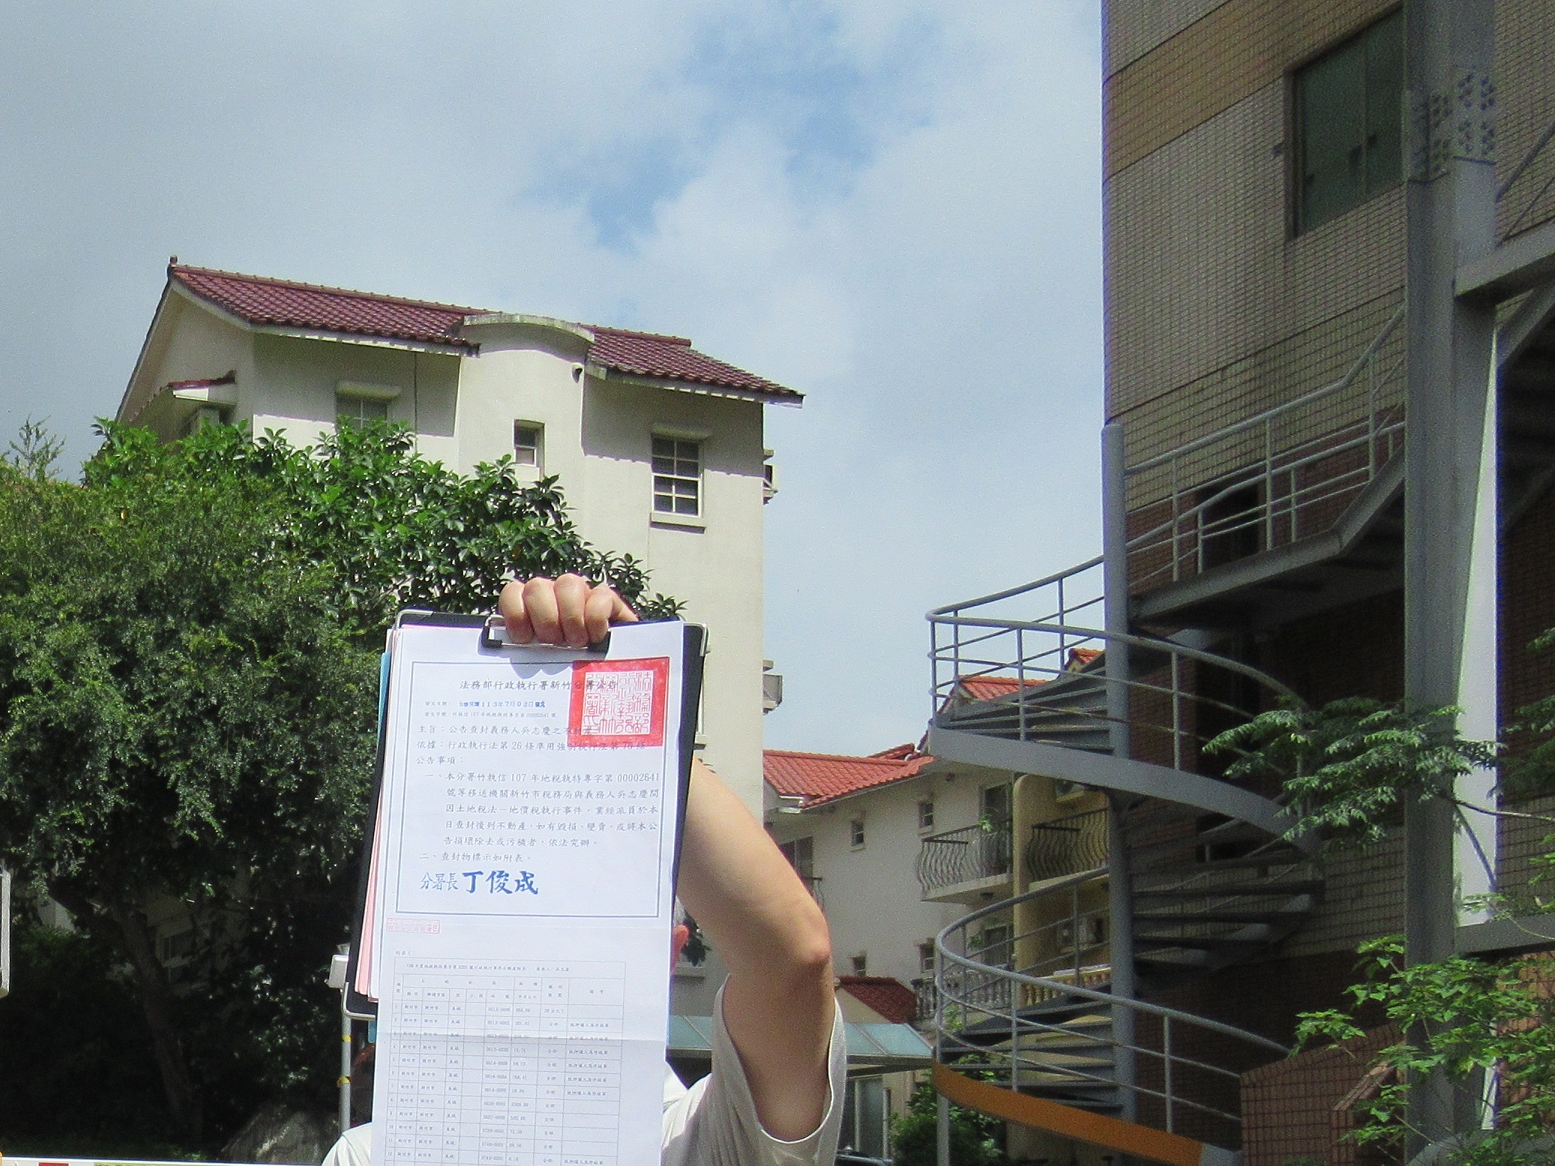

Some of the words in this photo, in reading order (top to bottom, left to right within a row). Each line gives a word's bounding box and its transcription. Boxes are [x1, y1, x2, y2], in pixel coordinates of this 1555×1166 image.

[419, 871, 459, 891] 分署長
[462, 869, 539, 895] 丁俊成
